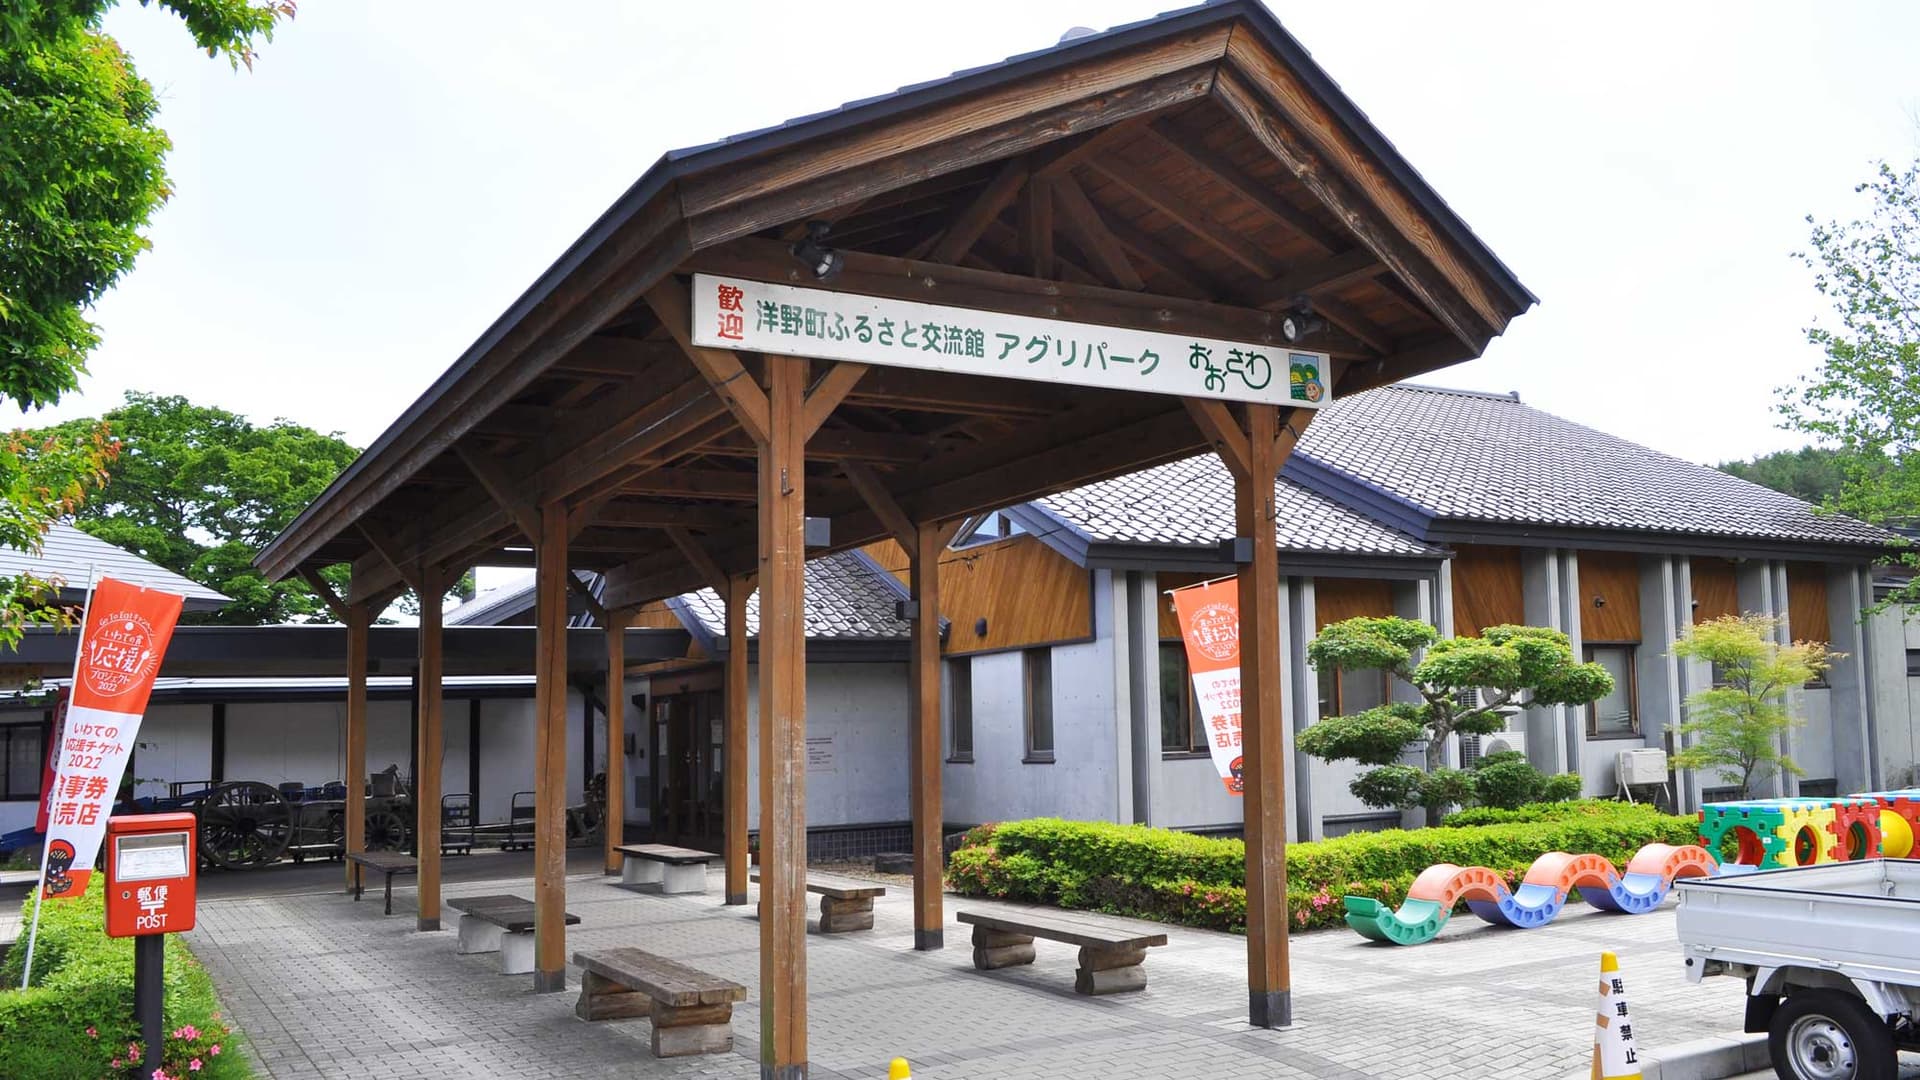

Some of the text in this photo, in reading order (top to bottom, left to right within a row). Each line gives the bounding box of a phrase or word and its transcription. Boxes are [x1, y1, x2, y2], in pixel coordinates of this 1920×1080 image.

[717, 284, 744, 341] 歓迎
[756, 299, 985, 359] 洋野町ふるさと交流館
[995, 333, 1160, 376] アグリパーク
[95, 642, 139, 673] 応援
[91, 670, 129, 685] プロジェクト
[98, 681, 117, 692] 2022
[74, 722, 118, 739] いわての
[65, 738, 124, 755] 応援チケット
[68, 754, 102, 769] 2022
[54, 802, 101, 825] 売店
[137, 885, 168, 903] 郵便
[136, 914, 168, 930] POST
[1611, 978, 1638, 1065] 駐車禁止
